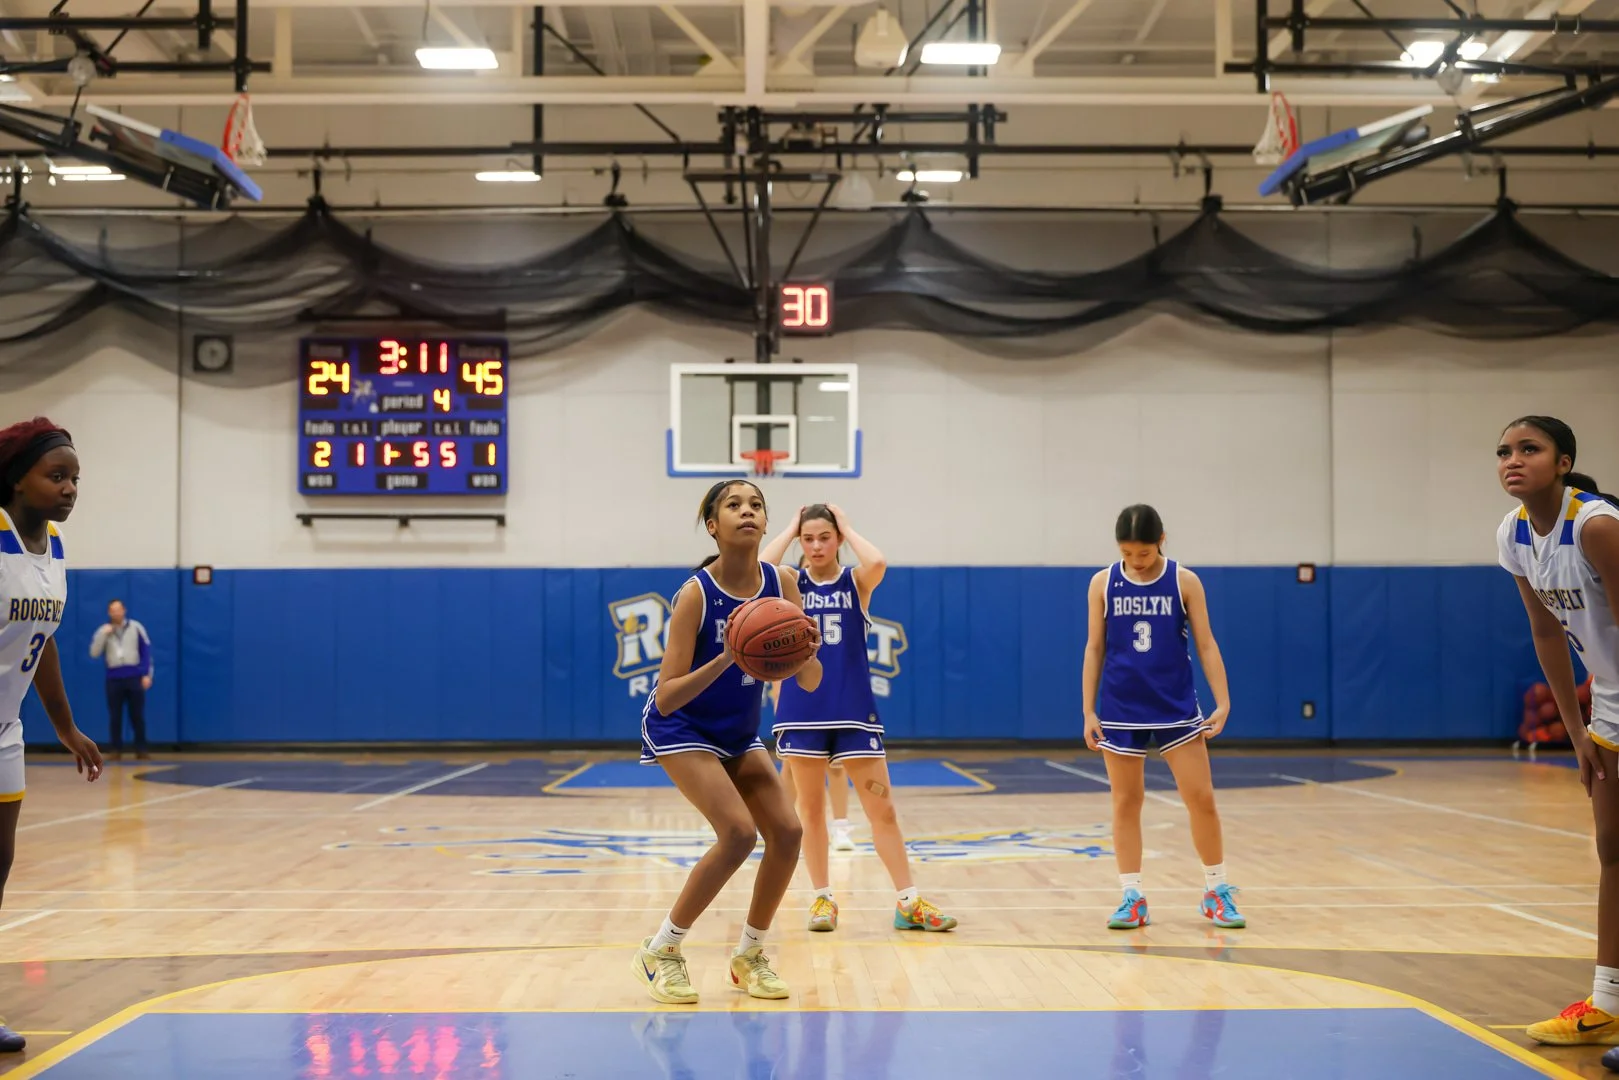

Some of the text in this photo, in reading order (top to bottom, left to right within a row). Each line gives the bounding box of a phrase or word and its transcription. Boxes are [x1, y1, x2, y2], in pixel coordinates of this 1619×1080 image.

[782, 287, 828, 326] 30
[380, 340, 448, 374] 3:11
[309, 361, 350, 395] 24
[462, 361, 503, 395] 45
[383, 394, 423, 411] period
[433, 388, 450, 412] 4
[381, 419, 422, 437] player
[314, 441, 331, 467] 2
[357, 443, 365, 466] 1
[413, 441, 430, 467] 5
[440, 441, 457, 467] 5
[488, 443, 496, 466] 1
[1113, 596, 1173, 616] ROSLYN
[1132, 620, 1152, 652] 3
[21, 632, 46, 672] 3
